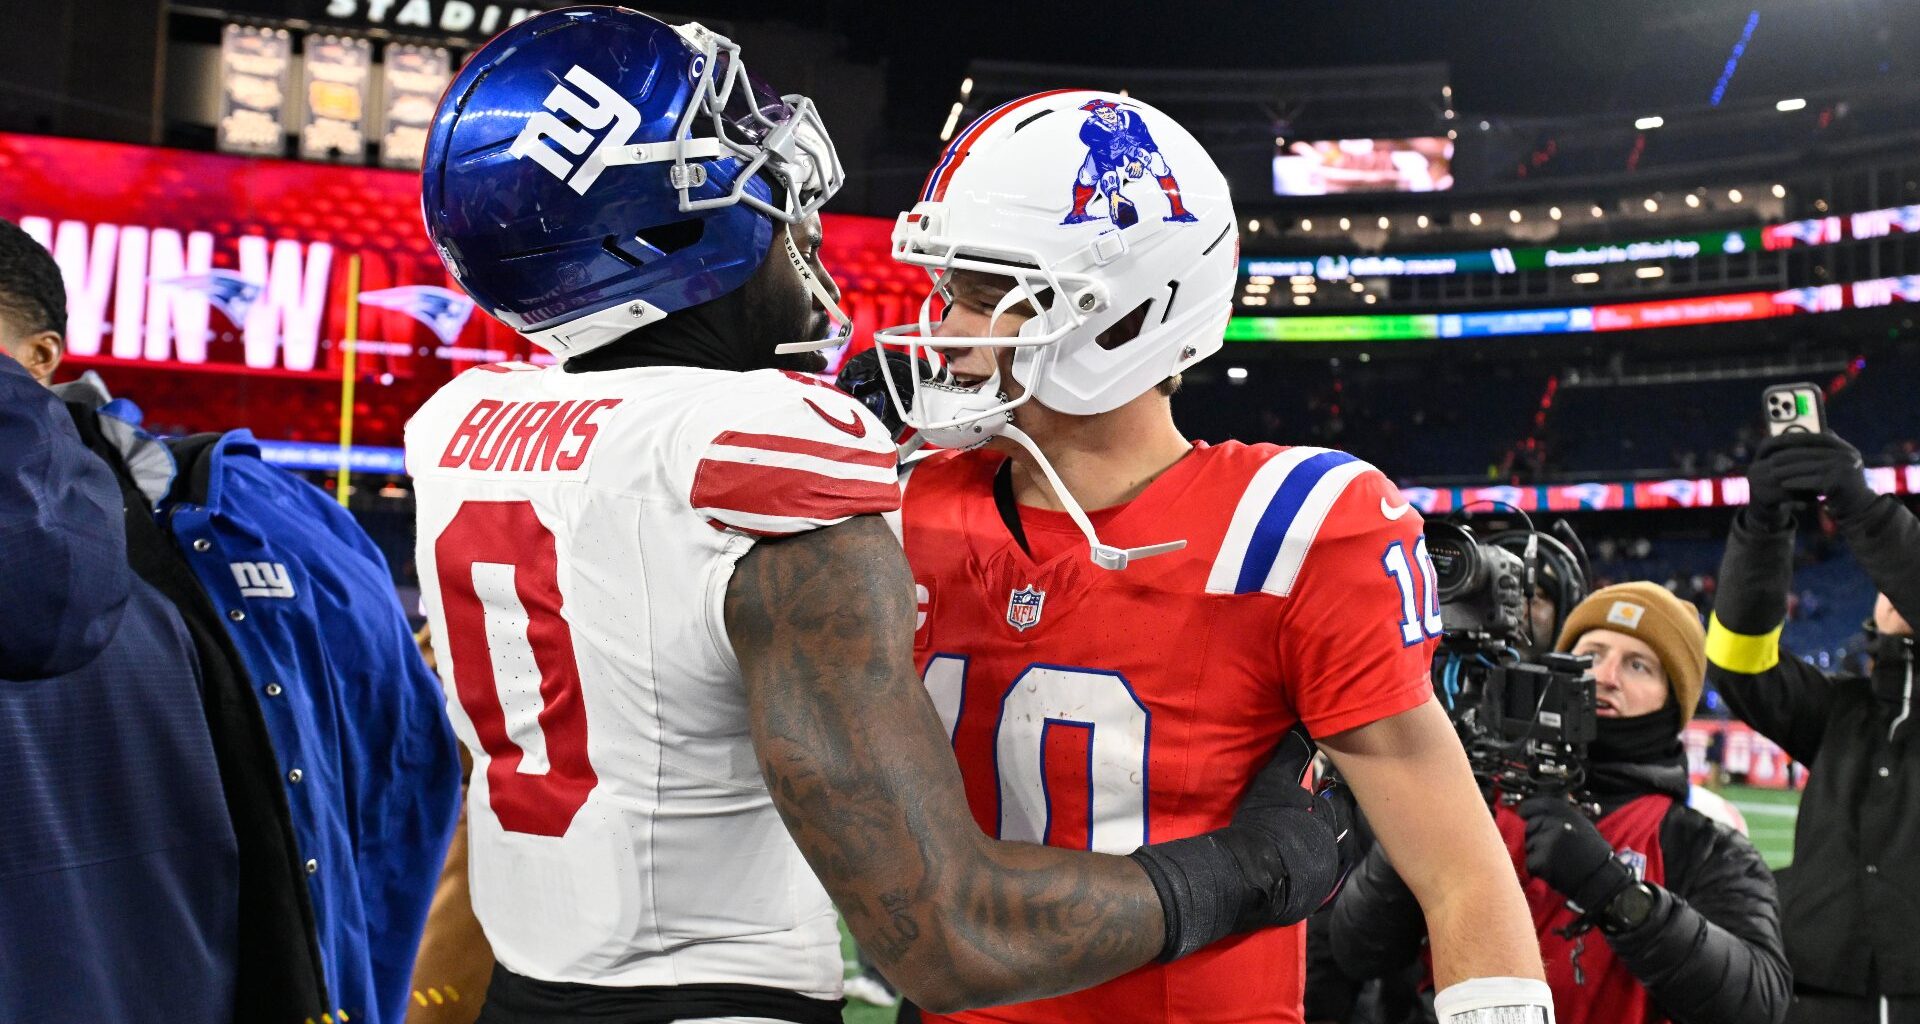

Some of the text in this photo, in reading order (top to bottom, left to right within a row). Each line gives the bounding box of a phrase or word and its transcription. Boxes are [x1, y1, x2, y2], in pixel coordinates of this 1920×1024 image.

[20, 216, 214, 364] WIN
[785, 237, 804, 271] SPORT
[438, 398, 623, 472] BURNS
[1012, 605, 1036, 622] NFL
[435, 500, 598, 837] 0
